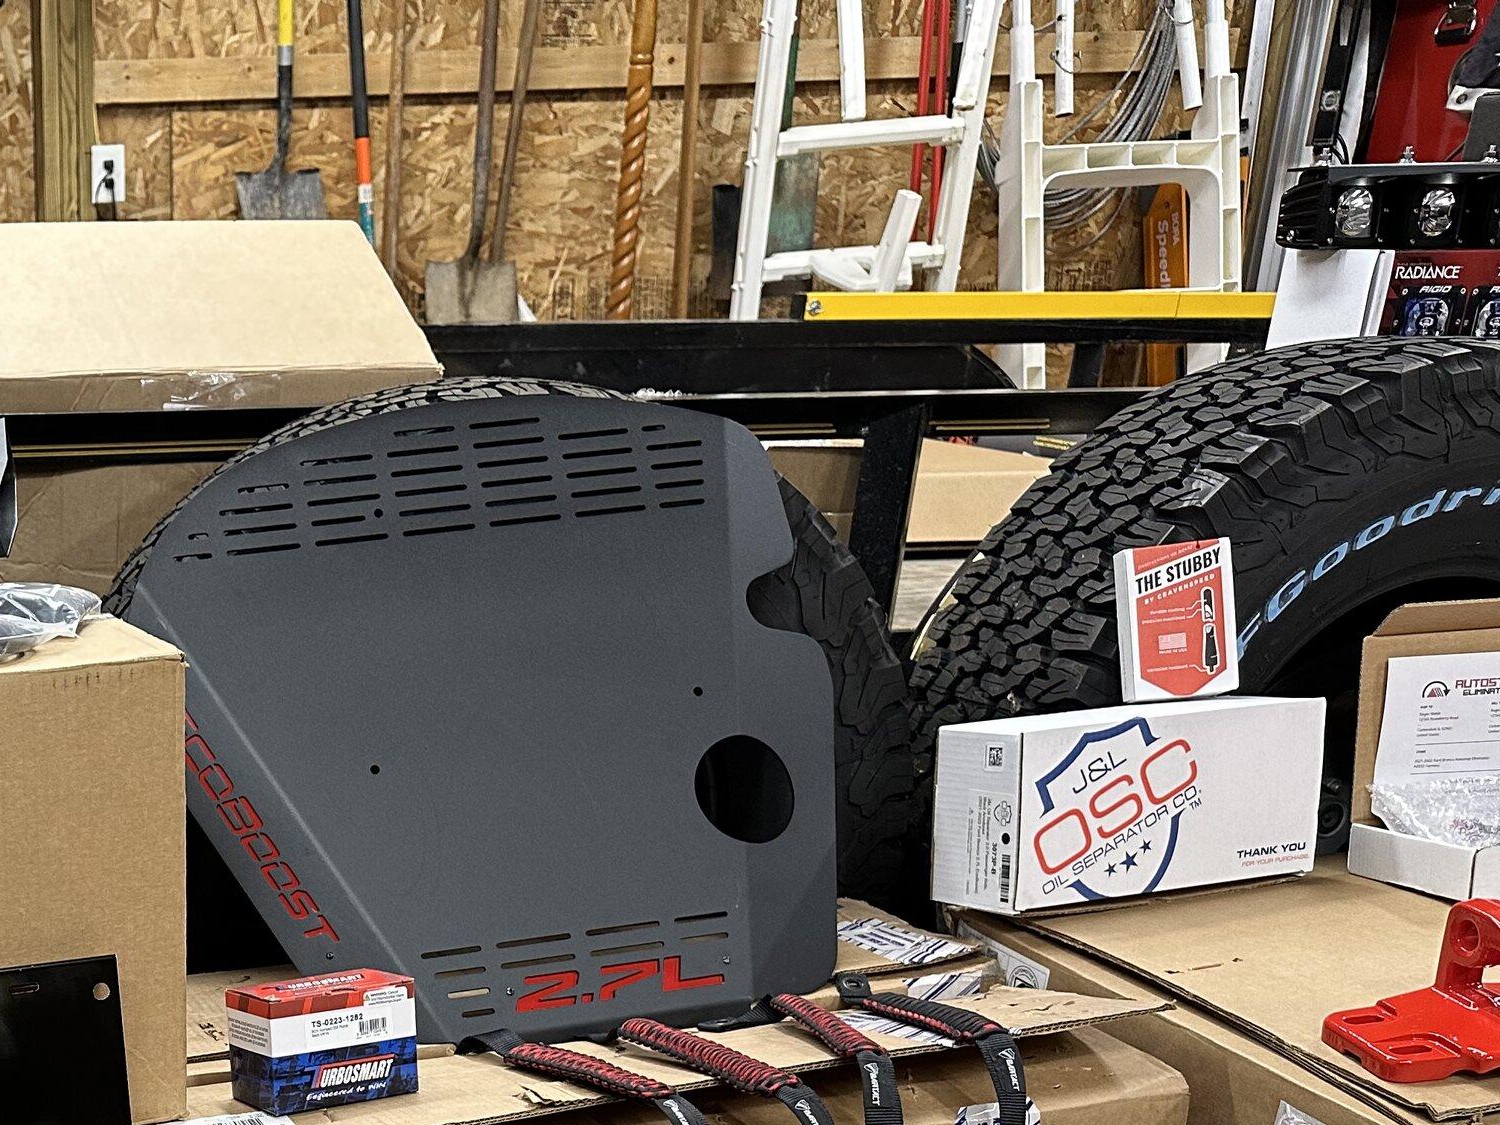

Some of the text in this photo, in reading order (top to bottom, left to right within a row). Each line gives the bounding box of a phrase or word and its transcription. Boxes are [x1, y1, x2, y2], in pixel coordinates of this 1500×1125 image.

[1156, 219, 1171, 288] Speed
[1394, 265, 1461, 280] RADIANCE
[1418, 285, 1453, 294] RIGID
[1135, 546, 1222, 595] THE STUBBY
[1143, 573, 1216, 606] BY CRAVENSPEED
[1072, 751, 1127, 794] J&L
[1033, 738, 1198, 876] OSC
[186, 709, 341, 943] COBOOST
[1041, 785, 1202, 895] OIL SEPARATOR CO.
[1237, 841, 1307, 859] THANK YOU
[1241, 859, 1255, 867] FOR
[1256, 857, 1274, 866] YOUR
[516, 955, 726, 1013] 2.7L
[311, 1013, 364, 1029] TS-0223-1282
[311, 1054, 397, 1089] TURBOSMART
[306, 1086, 353, 1102] Engineered
[356, 1084, 365, 1093] to
